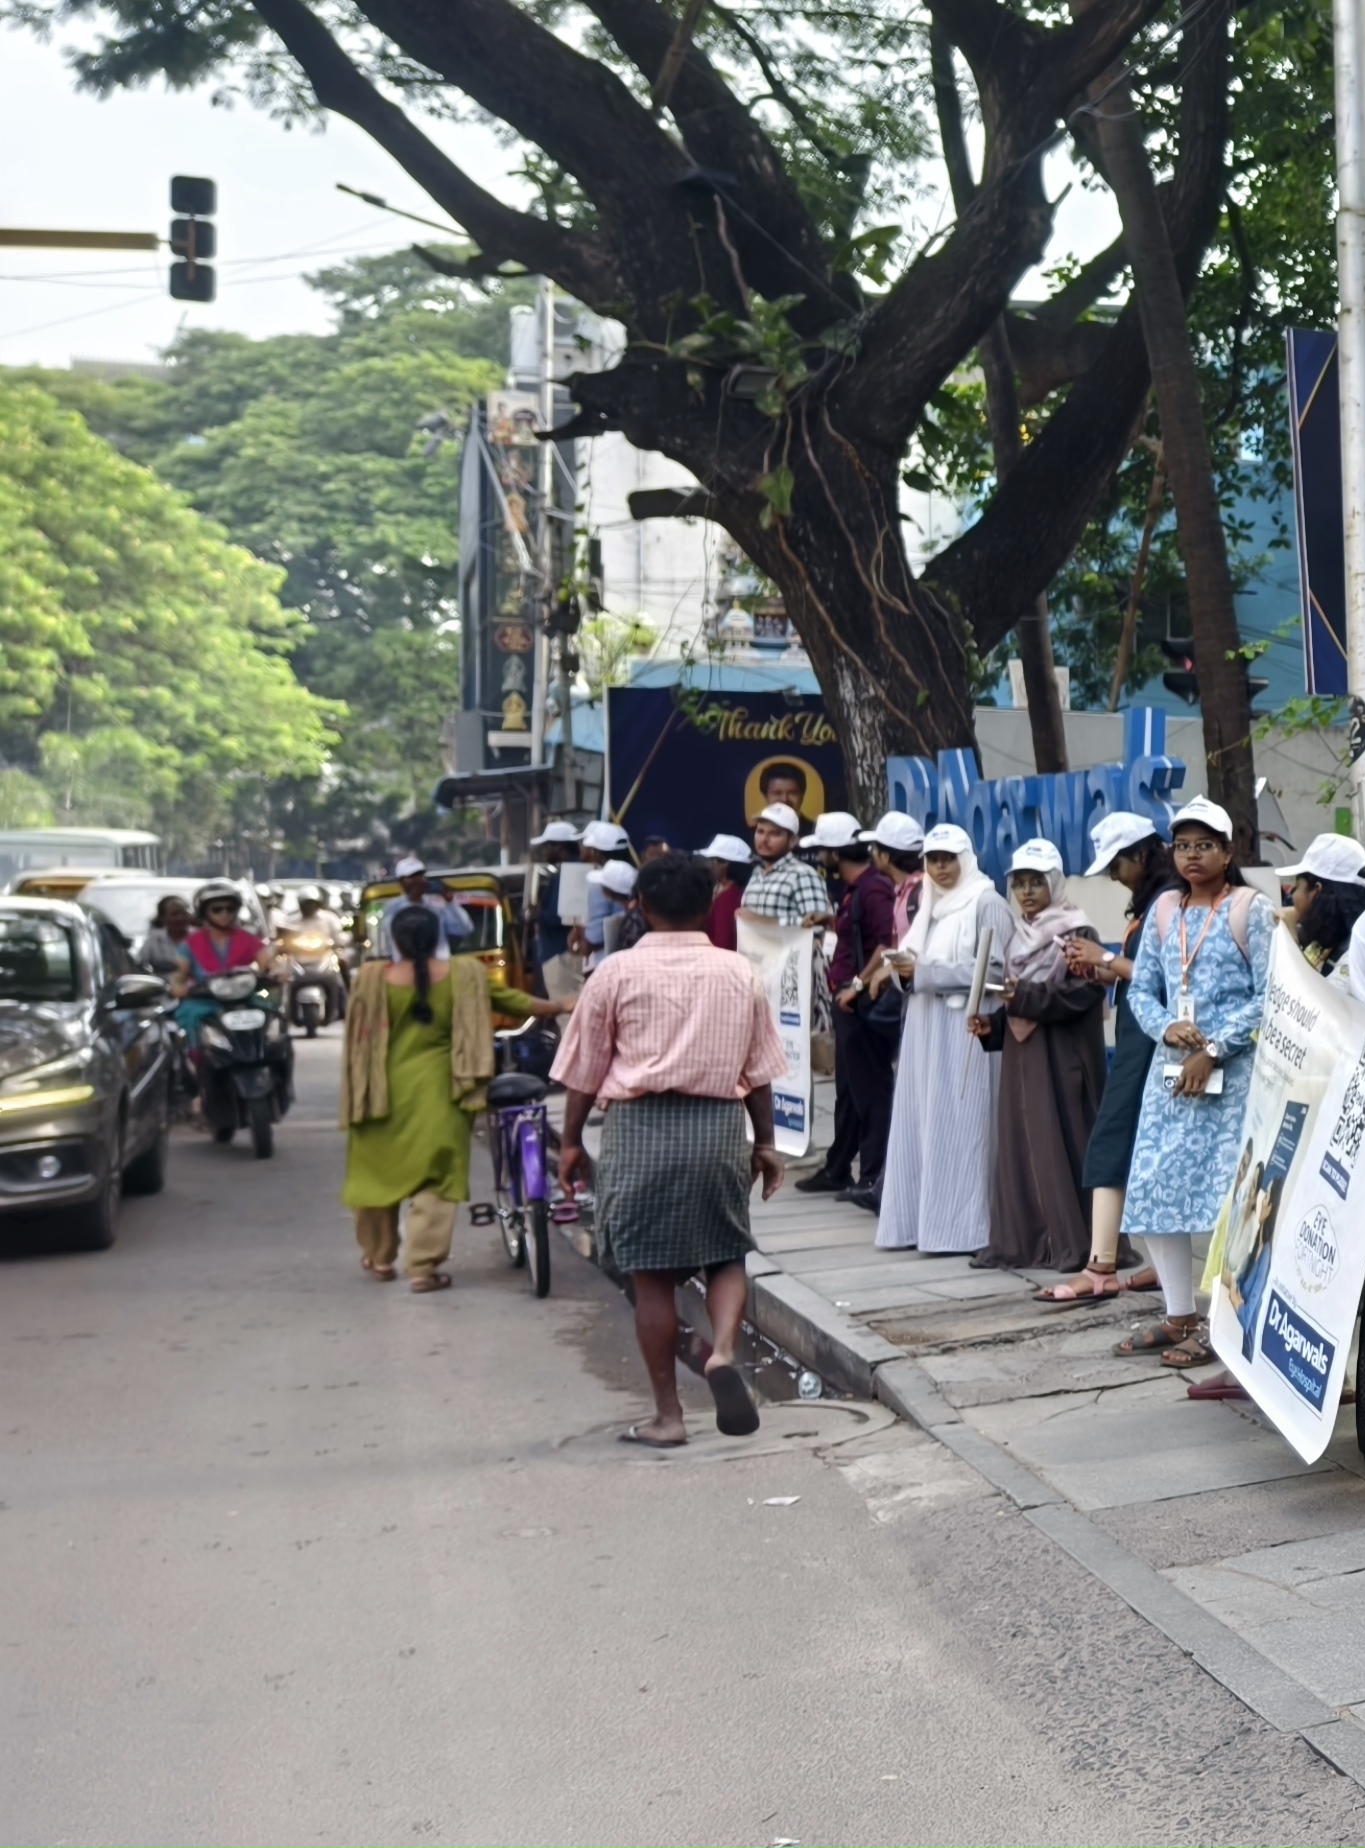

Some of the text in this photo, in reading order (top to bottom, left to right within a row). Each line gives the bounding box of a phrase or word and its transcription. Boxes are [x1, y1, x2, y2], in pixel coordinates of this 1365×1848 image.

[713, 706, 838, 746] Thank Yo
[1279, 1036, 1307, 1070] secret
[1299, 1221, 1336, 1266] DONATION
[1313, 1211, 1328, 1236] EYE
[1268, 1299, 1282, 1330] Dr
[1278, 1312, 1328, 1375] Agarwals
